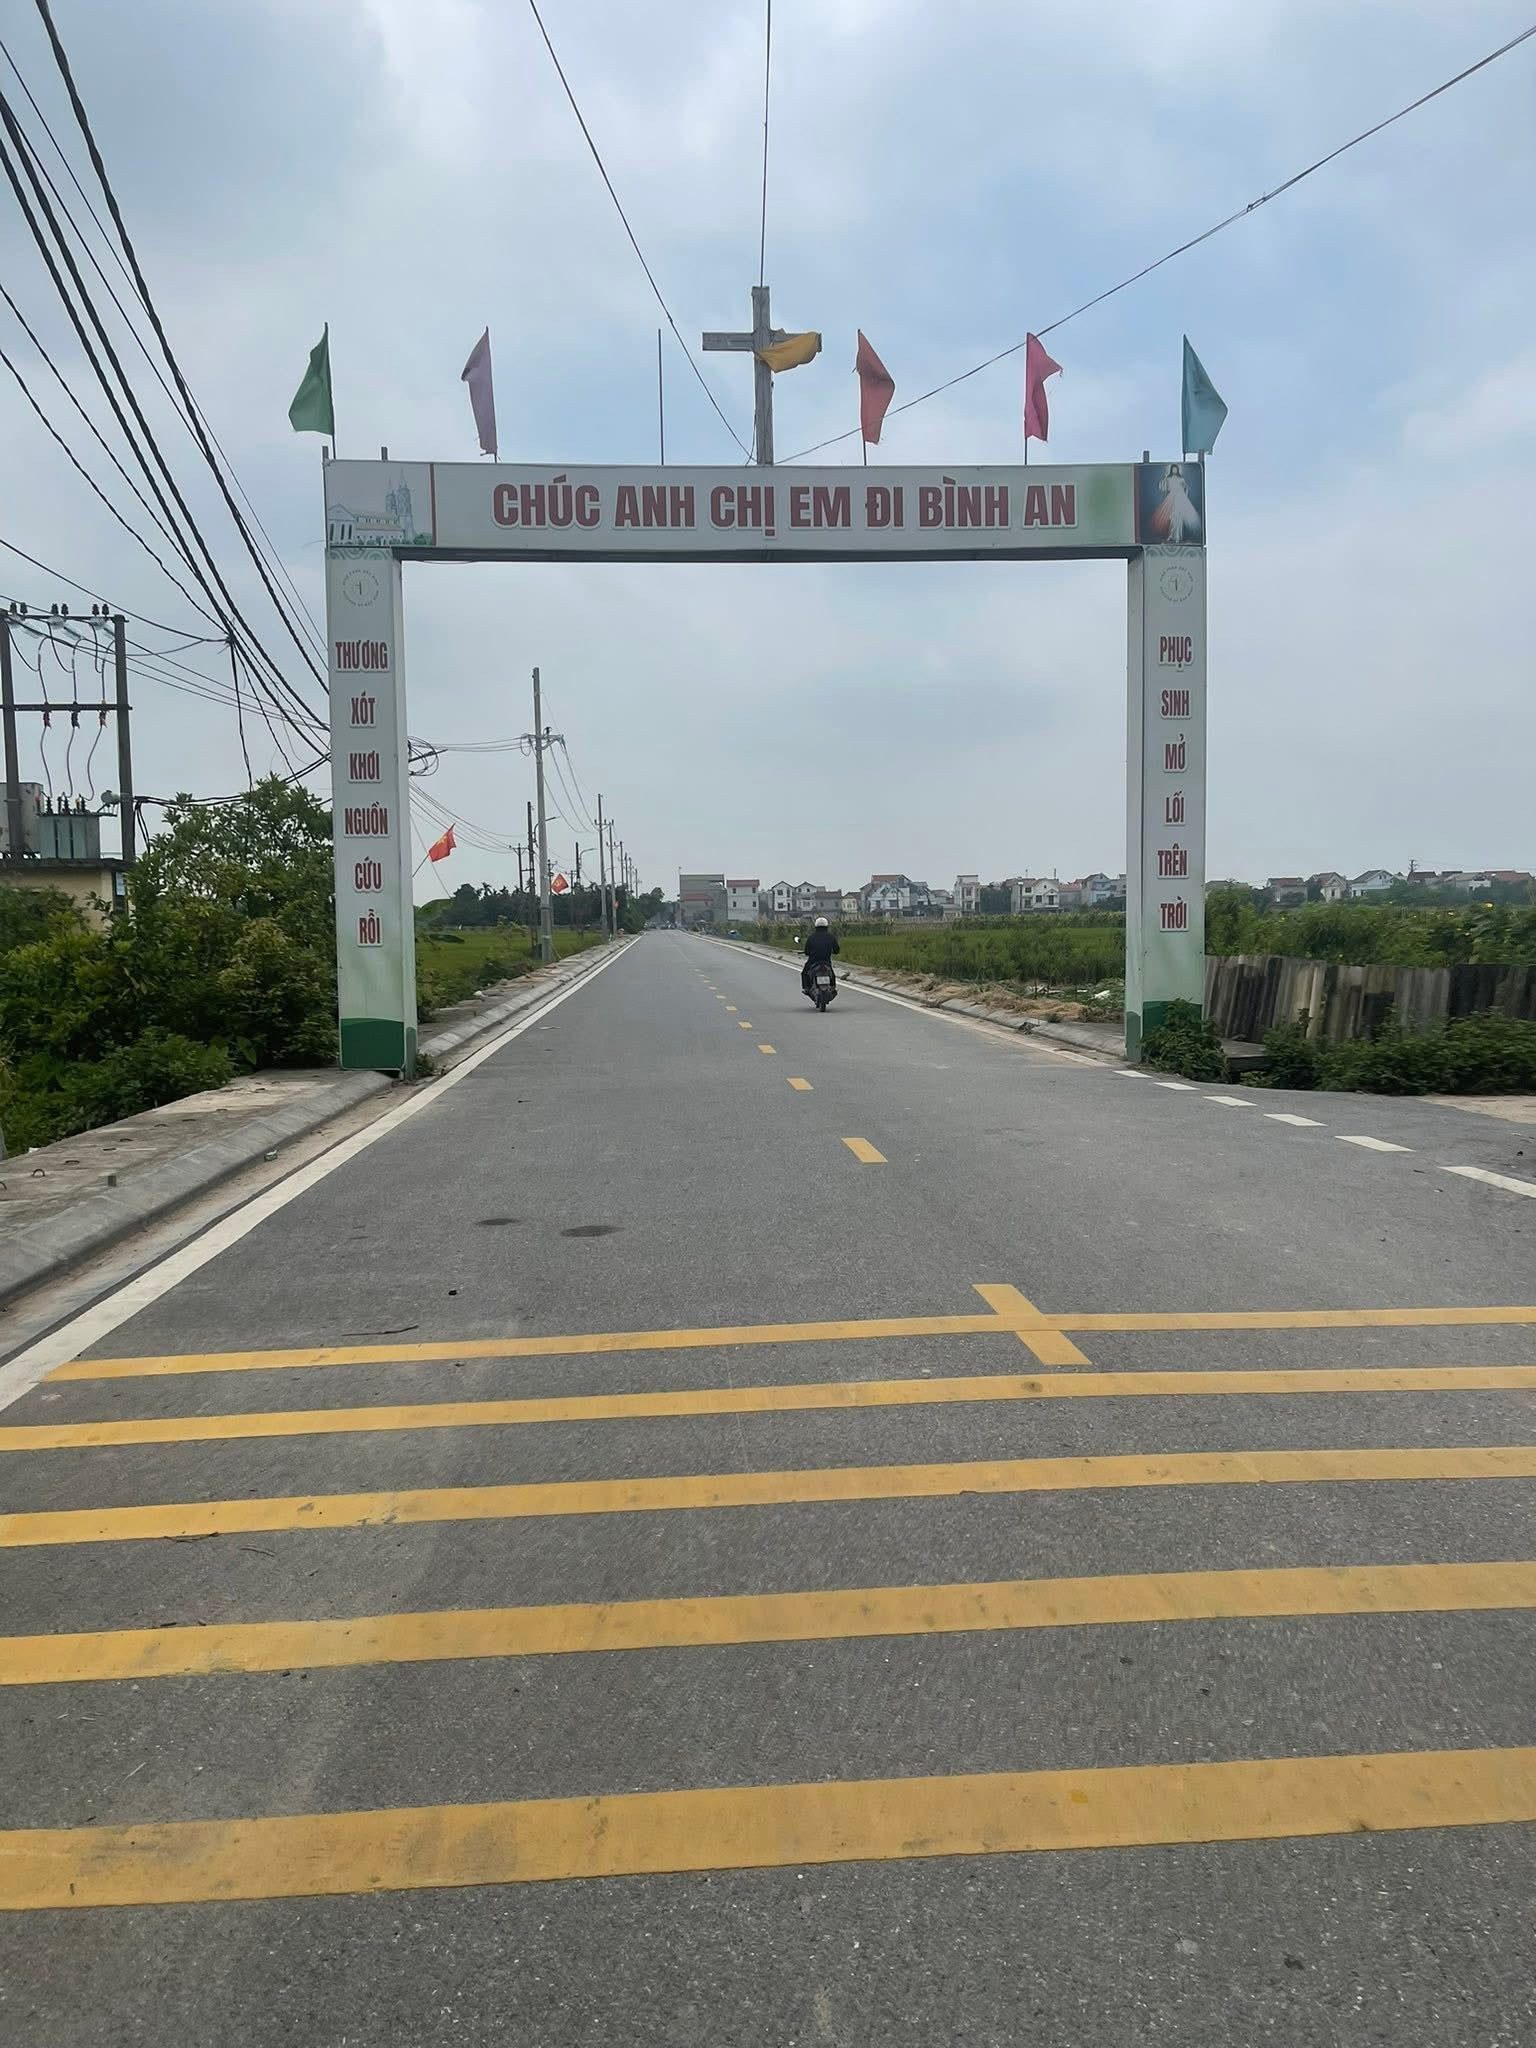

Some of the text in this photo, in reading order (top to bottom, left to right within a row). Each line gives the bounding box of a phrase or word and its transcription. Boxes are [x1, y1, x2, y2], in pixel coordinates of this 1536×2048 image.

[493, 474, 1076, 537] CHÚC ANH CHỊ EM ĐI BÌNH AN
[335, 639, 388, 669] THƯƠNG
[1160, 636, 1192, 668] PHỤC
[351, 691, 376, 725] XÓT
[1161, 690, 1190, 716] SINH
[350, 750, 380, 779] KHƠI
[1165, 733, 1186, 770] MỞ
[345, 801, 388, 834] NGUỒN
[1165, 790, 1185, 823] LỐI
[355, 856, 382, 890] CỨU
[1158, 843, 1188, 876] TRÊN
[1160, 896, 1187, 929] TRỜI
